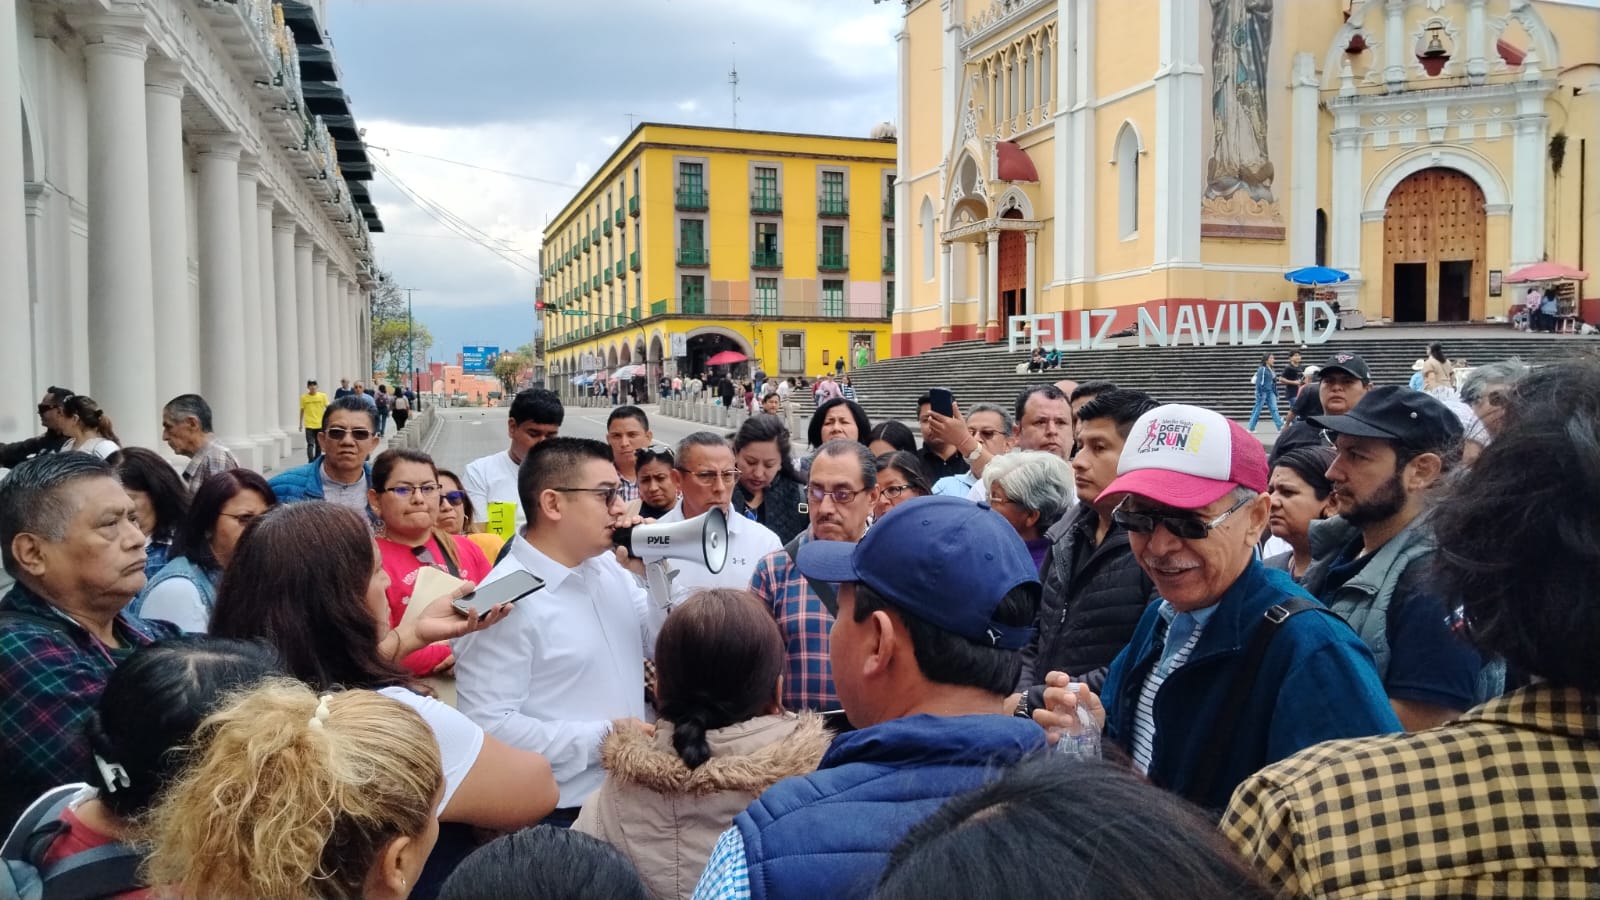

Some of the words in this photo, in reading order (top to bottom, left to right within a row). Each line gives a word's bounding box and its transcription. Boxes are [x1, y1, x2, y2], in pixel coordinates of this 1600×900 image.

[1008, 310, 1119, 353] FELIZ
[1137, 301, 1338, 348] NAVIDAD
[1156, 432, 1189, 448] RUN
[647, 535, 671, 545] PYLE
